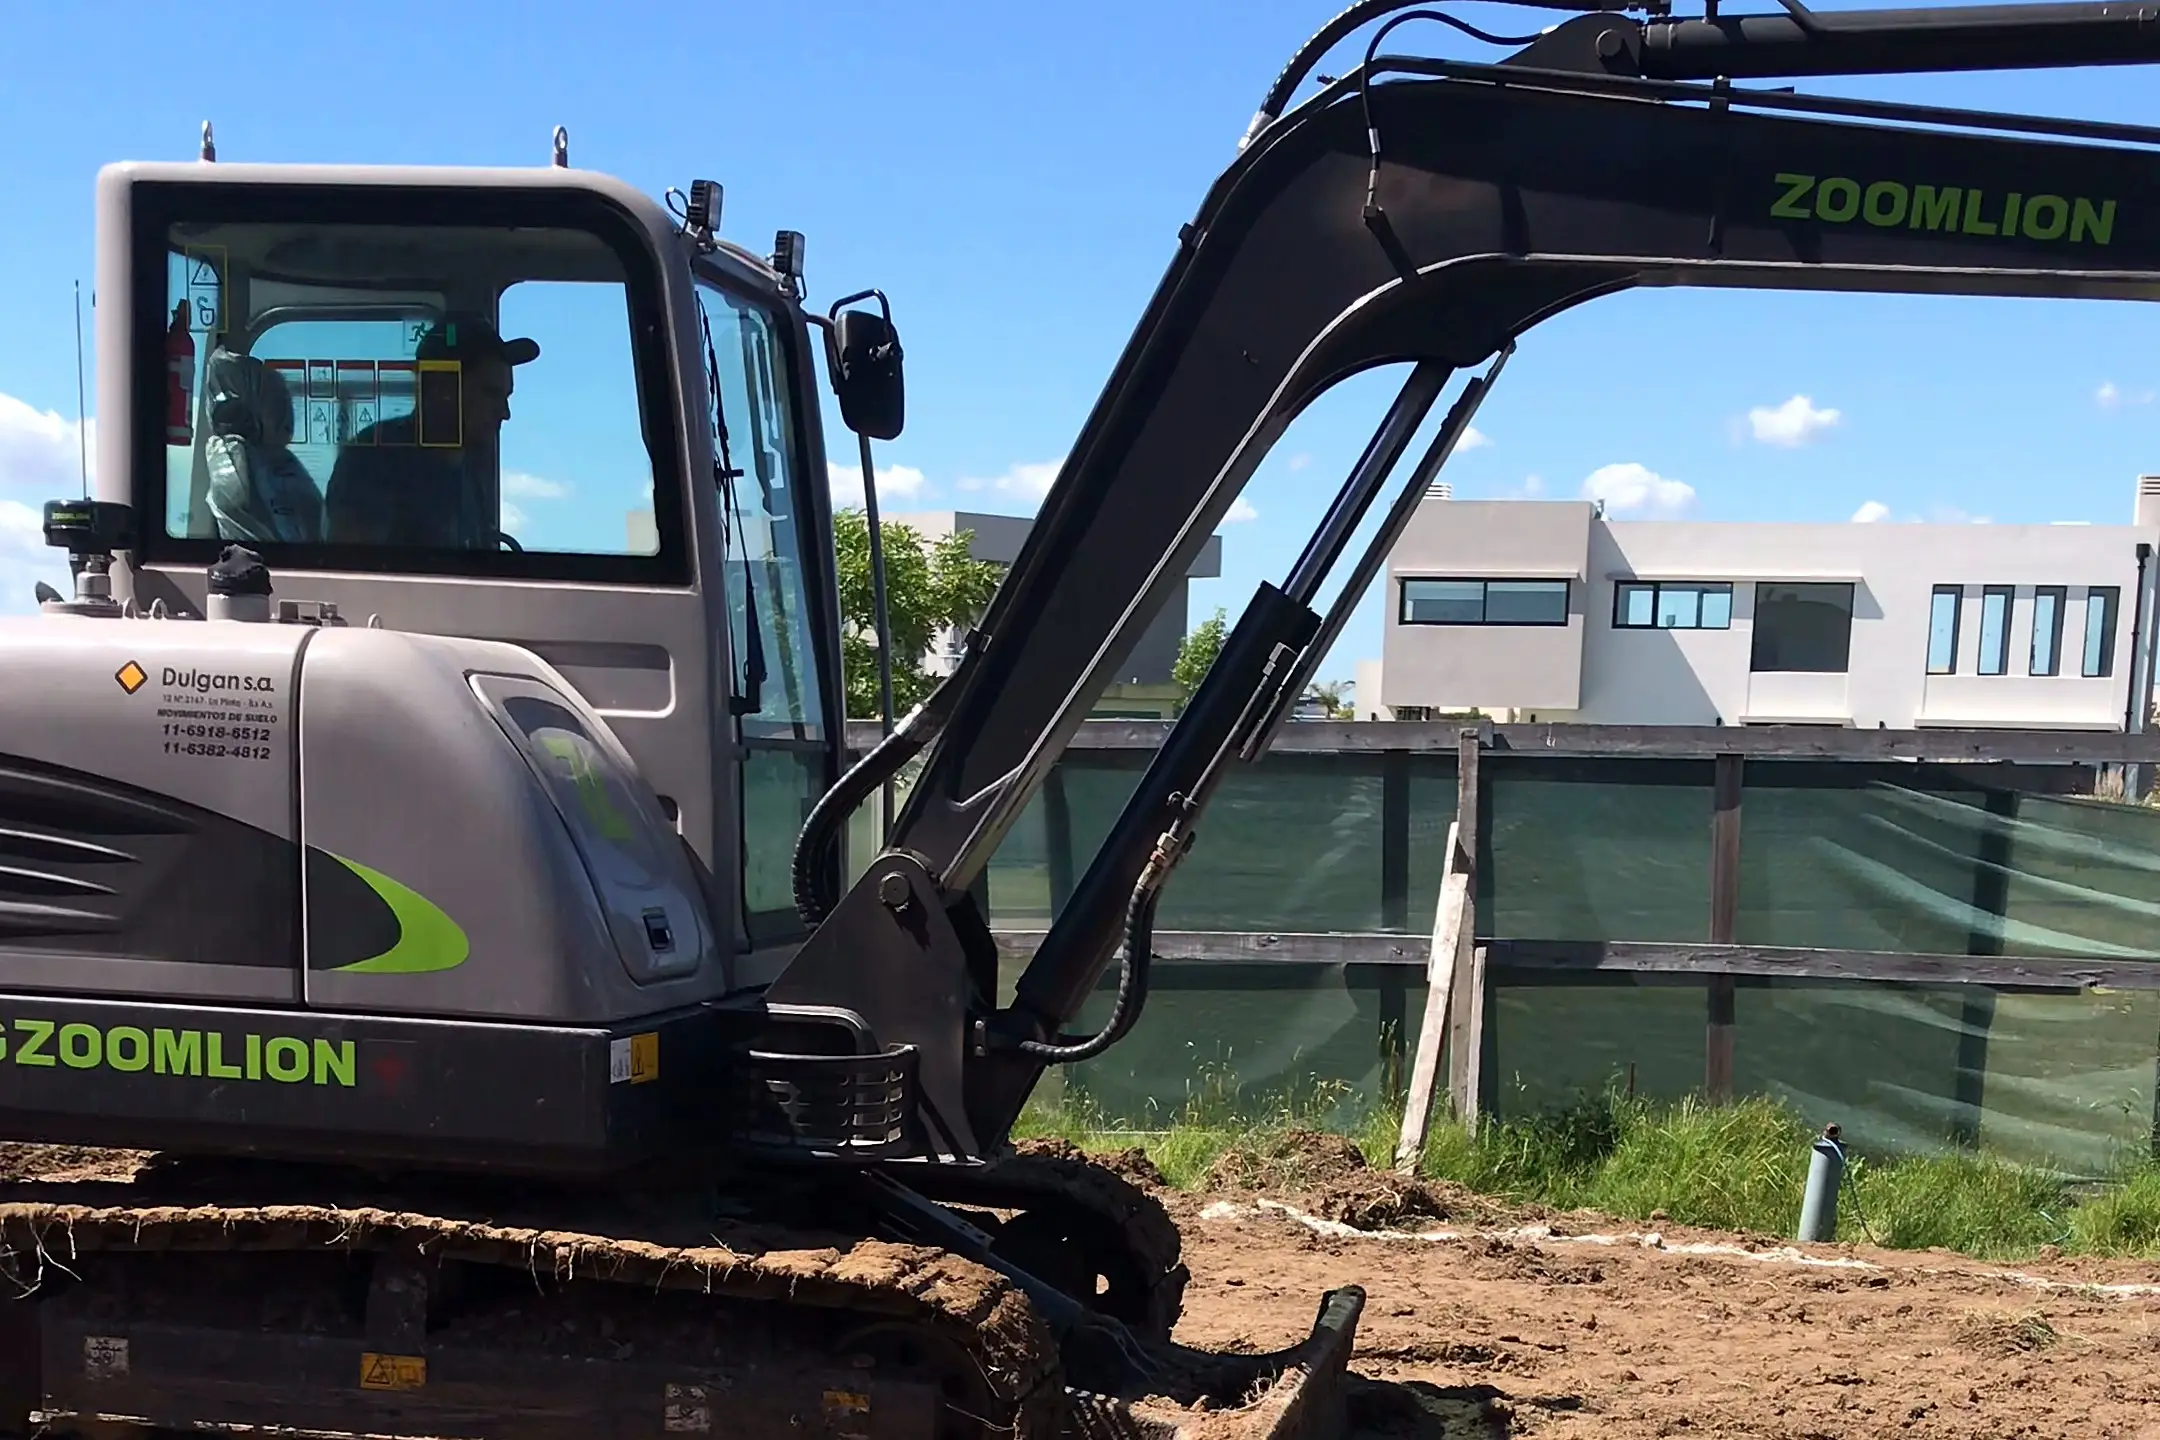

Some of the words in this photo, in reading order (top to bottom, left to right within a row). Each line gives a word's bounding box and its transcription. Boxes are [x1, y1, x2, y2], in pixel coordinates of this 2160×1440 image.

[1770, 173, 2116, 245] ZOOMLION
[162, 667, 240, 693] Dulgan
[157, 708, 226, 721] MOVIMIENTOS
[228, 712, 242, 722] DE
[244, 713, 278, 724] SUELO
[15, 1019, 356, 1087] ZOOMLION
